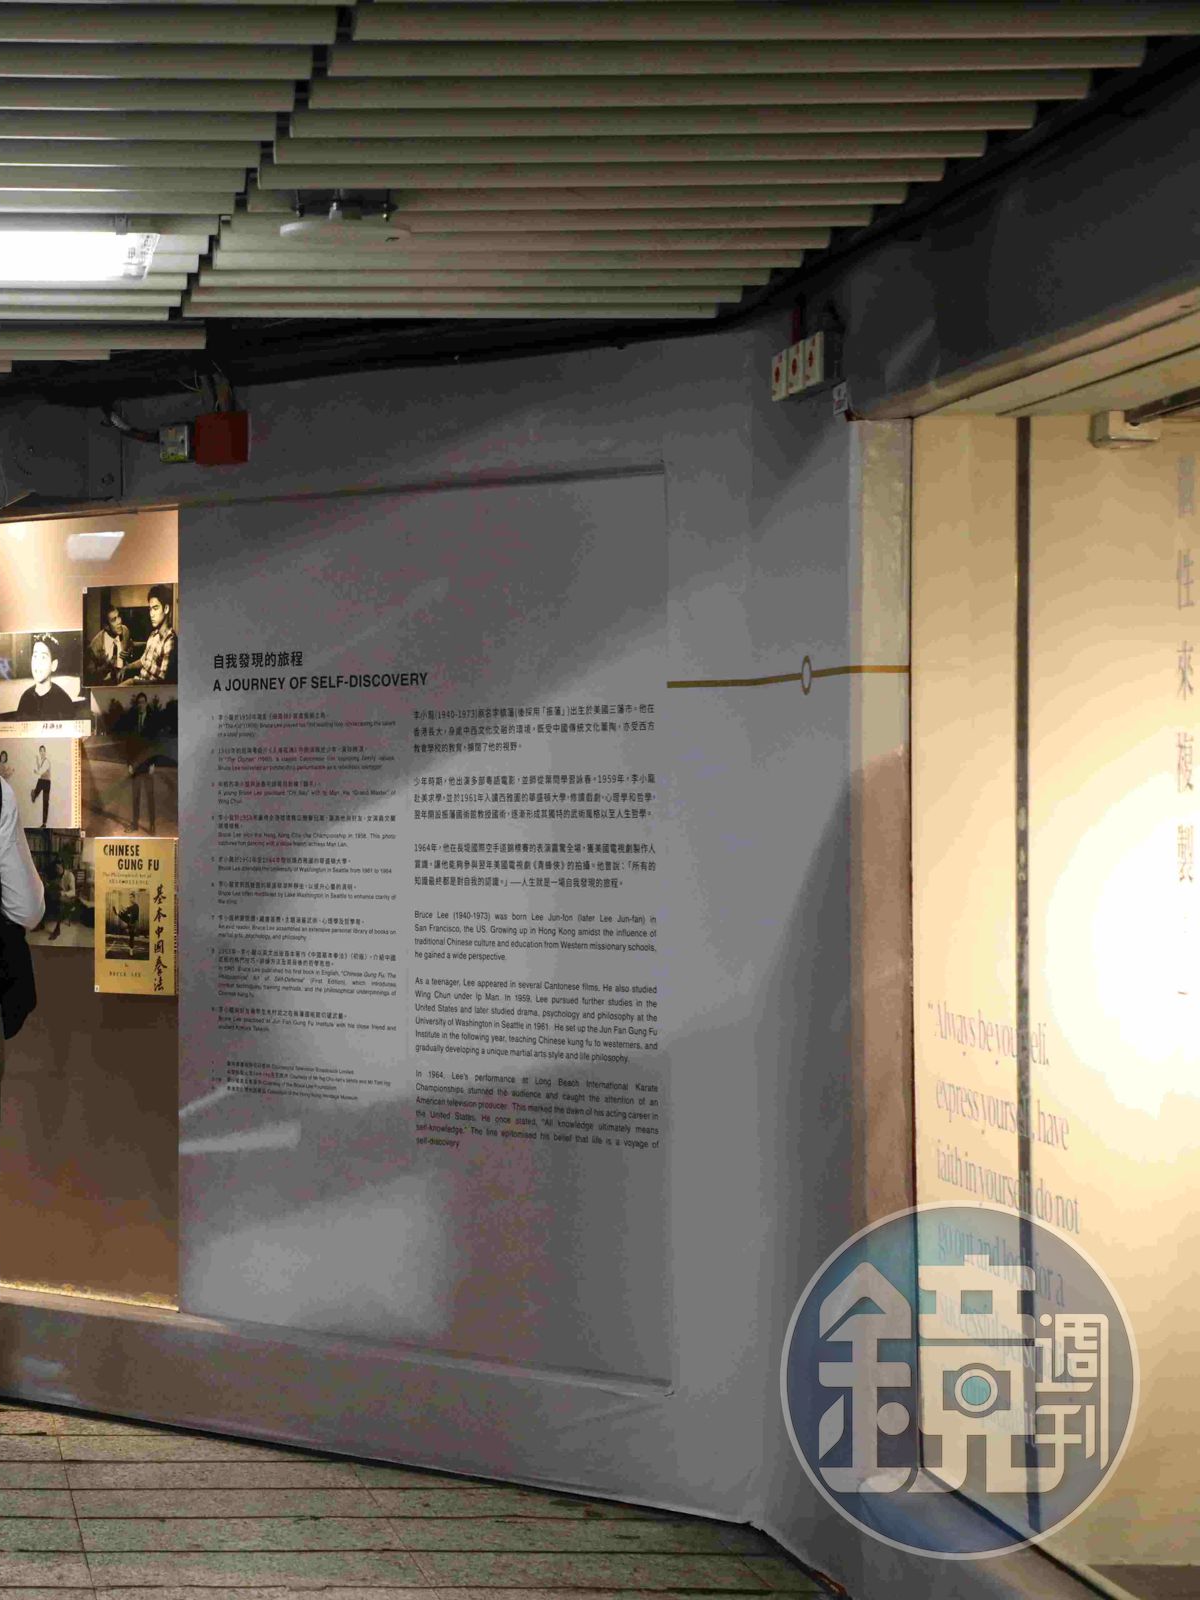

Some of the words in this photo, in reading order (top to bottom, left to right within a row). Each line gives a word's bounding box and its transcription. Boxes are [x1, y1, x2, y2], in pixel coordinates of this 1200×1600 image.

[213, 651, 303, 669] 自我發現的旅程
[214, 678, 221, 692] A
[225, 676, 285, 692] JOURNEY
[289, 676, 307, 690] OF
[311, 673, 427, 690] SELF-DISCOVERY
[103, 844, 140, 857] CHINESE
[118, 859, 143, 871] GUNG
[148, 859, 160, 871] FU
[489, 926, 518, 935] Growing
[538, 927, 557, 936] Hong
[558, 928, 576, 936] Kong
[616, 929, 648, 937] influence
[414, 938, 446, 946] traditional
[446, 938, 473, 946] Chinese
[510, 940, 543, 948] education
[560, 941, 589, 949] Western
[589, 942, 627, 951] missionary
[424, 951, 446, 960] gained
[477, 980, 508, 989] appeared
[518, 981, 542, 989] several
[543, 982, 580, 990] Cantonese
[632, 984, 658, 993] studied
[415, 991, 432, 1000] Wing
[433, 992, 452, 1000] Chun
[453, 992, 473, 1000] under
[551, 996, 579, 1005] pursued
[582, 997, 605, 1005] further
[608, 998, 633, 1006] studies
[415, 1004, 436, 1012] United
[437, 1005, 458, 1013] States
[460, 1006, 473, 1014] and
[474, 1006, 489, 1014] later
[490, 1007, 515, 1016] studied
[542, 1009, 580, 1020] psychology
[582, 1011, 595, 1019] and
[597, 1012, 635, 1022] philosophy
[415, 1017, 447, 1027] University
[455, 1019, 493, 1029] Washington
[501, 1021, 524, 1029] Seattle
[599, 1025, 612, 1033] Jun
[613, 1026, 627, 1034] Fan
[628, 1027, 648, 1036] Gung
[415, 1030, 440, 1039] Institute
[461, 1032, 490, 1042] following
[508, 1035, 537, 1045] teaching
[538, 1036, 566, 1045] Chinese
[567, 1038, 584, 1047] kung
[644, 1041, 658, 1049] and
[936, 1079, 980, 1123] express
[1037, 1098, 1070, 1150] have
[1036, 1177, 1053, 1224] do
[1055, 1193, 1081, 1235] not
